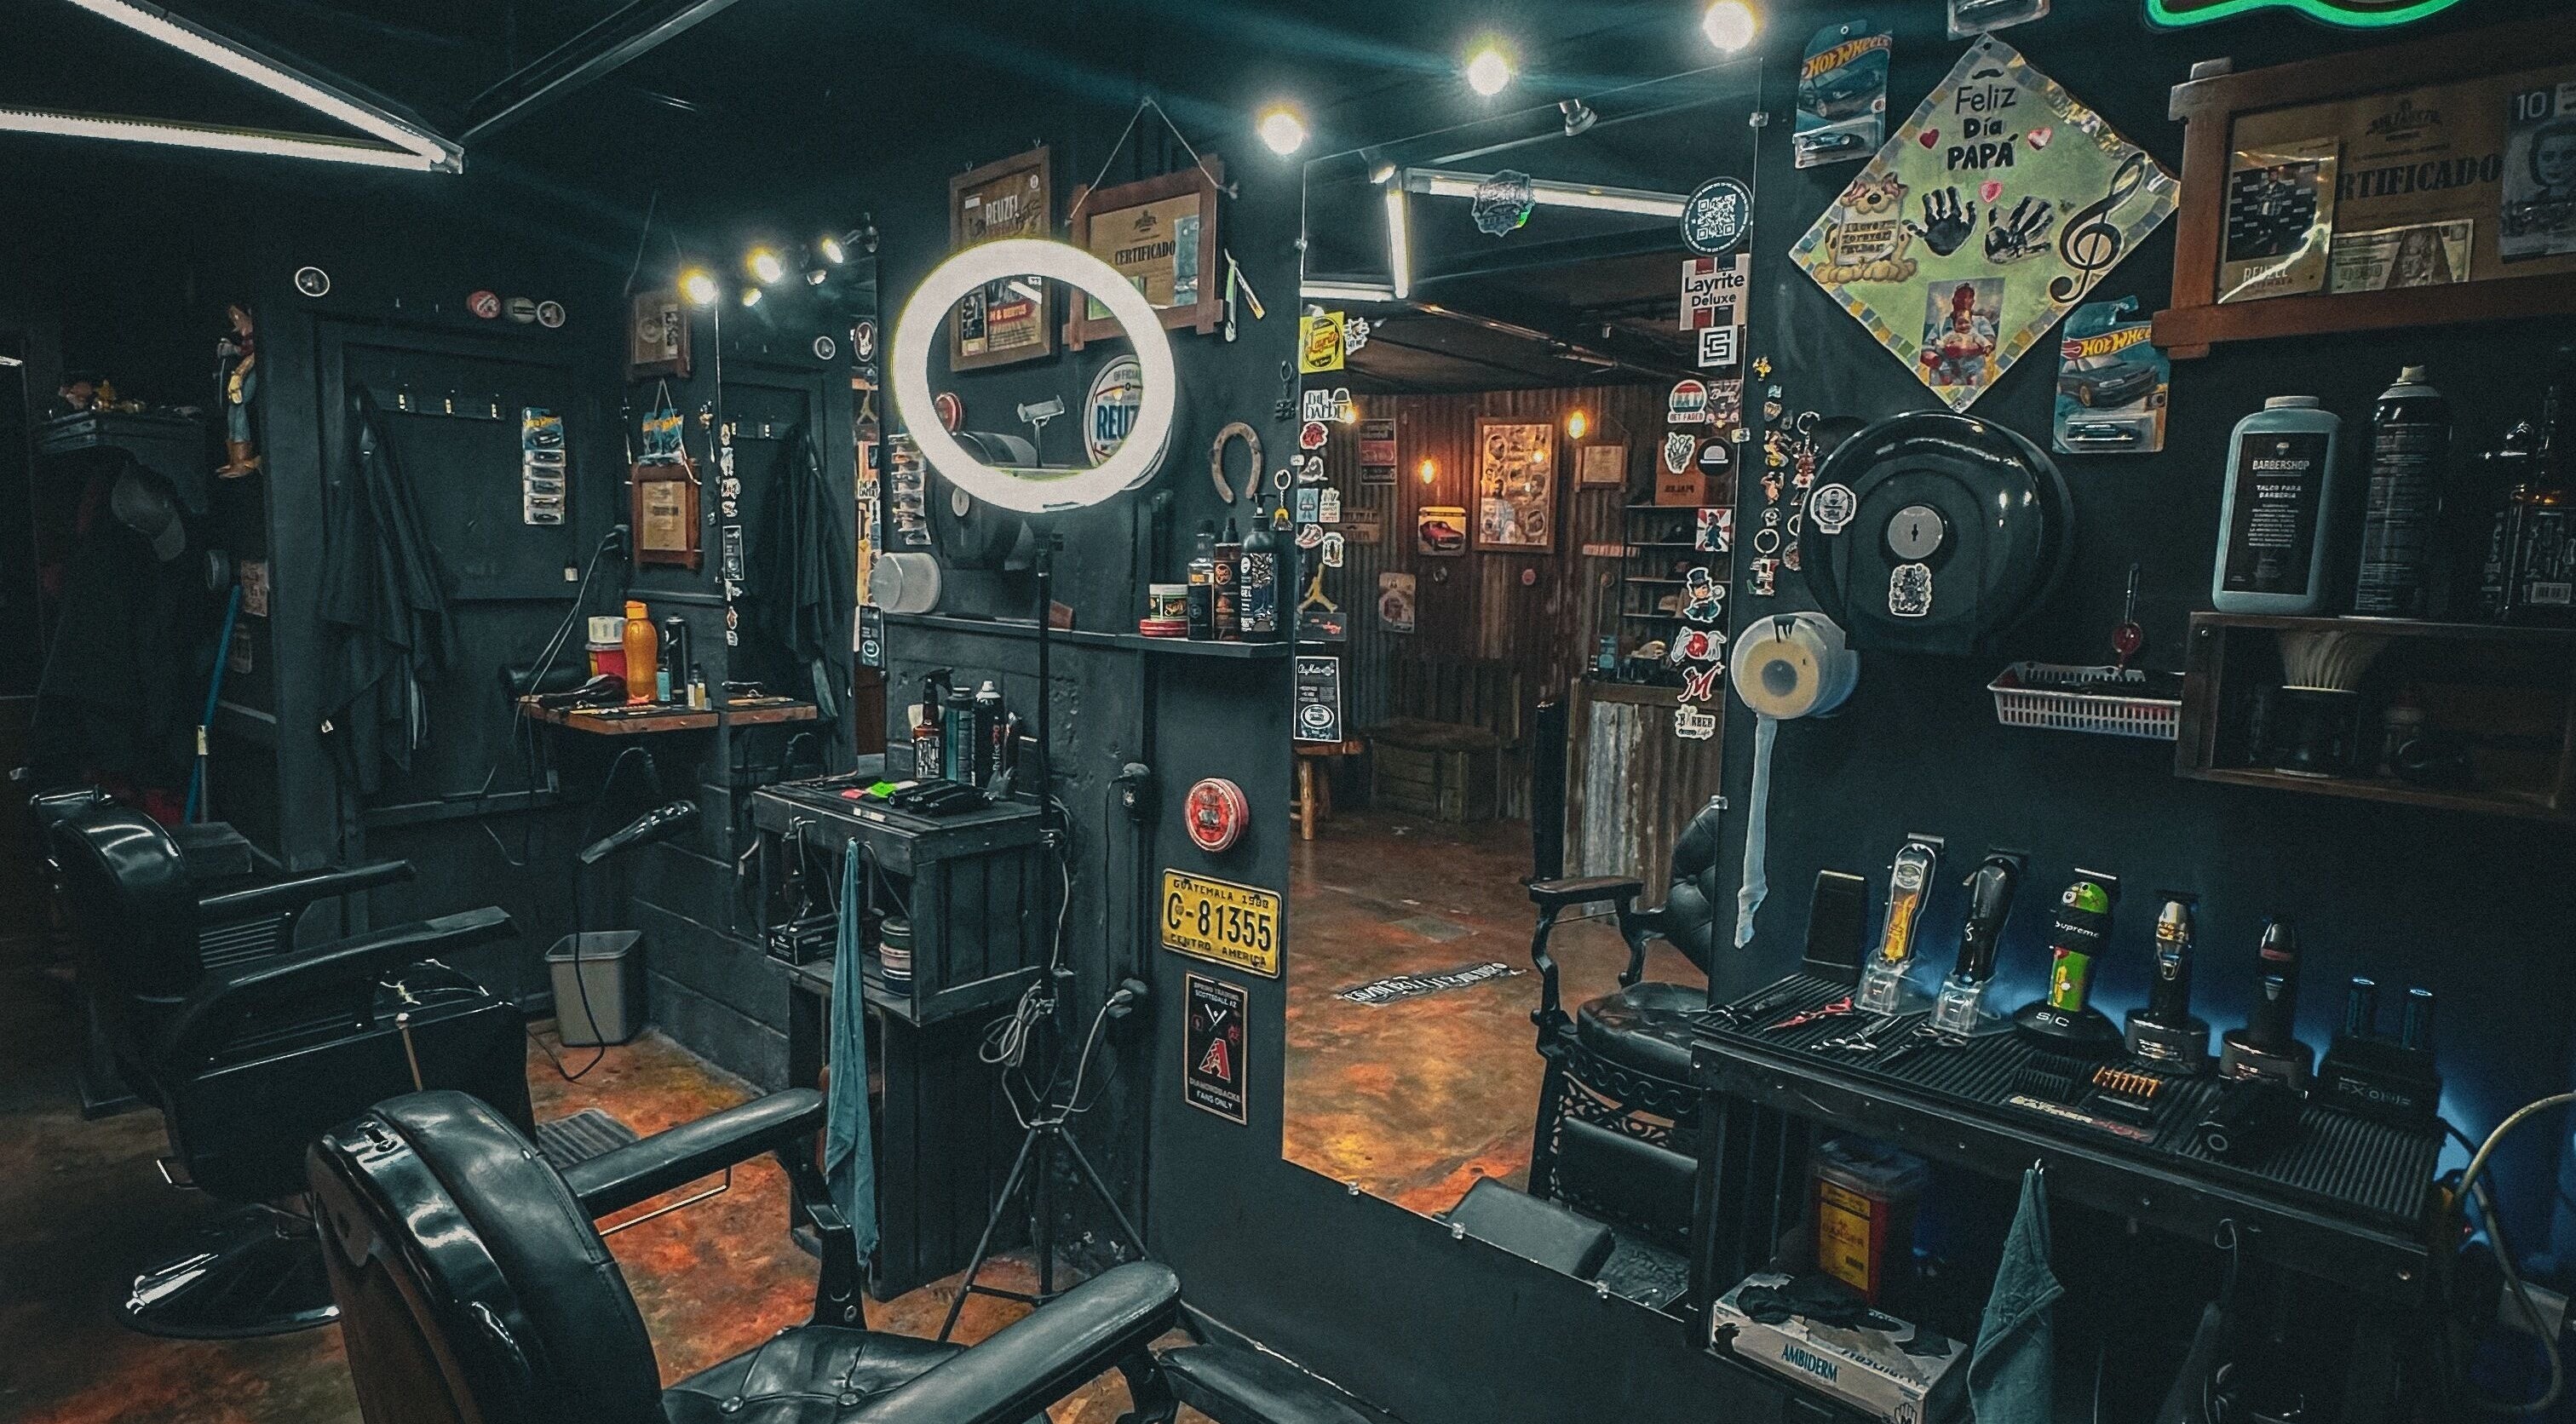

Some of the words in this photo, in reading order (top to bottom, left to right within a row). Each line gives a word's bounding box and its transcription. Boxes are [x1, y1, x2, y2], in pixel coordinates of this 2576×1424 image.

[1807, 53, 1839, 79] HOT
[1837, 37, 1889, 65] WHEELS
[1956, 84, 2016, 114] Feliz
[2517, 91, 2547, 121] 10
[1964, 117, 2003, 139] Día
[1947, 134, 2019, 170] PAPÁ
[1115, 239, 1176, 266] CERTIFICADO
[1685, 273, 1745, 296] Layrite
[1692, 293, 1736, 307] Deluxe
[2079, 338, 2113, 357] HOT
[2252, 460, 2309, 470] BARBERSHOP
[1173, 879, 1233, 901] GUATEMALA
[1168, 893, 1271, 951] C-81355
[1171, 933, 1211, 950] CENTRO
[1222, 947, 1267, 967] AMERICA
[1197, 1090, 1214, 1104] FANS
[1214, 1097, 1233, 1110] ONLY
[1780, 1343, 1838, 1382] AMBIDERM
